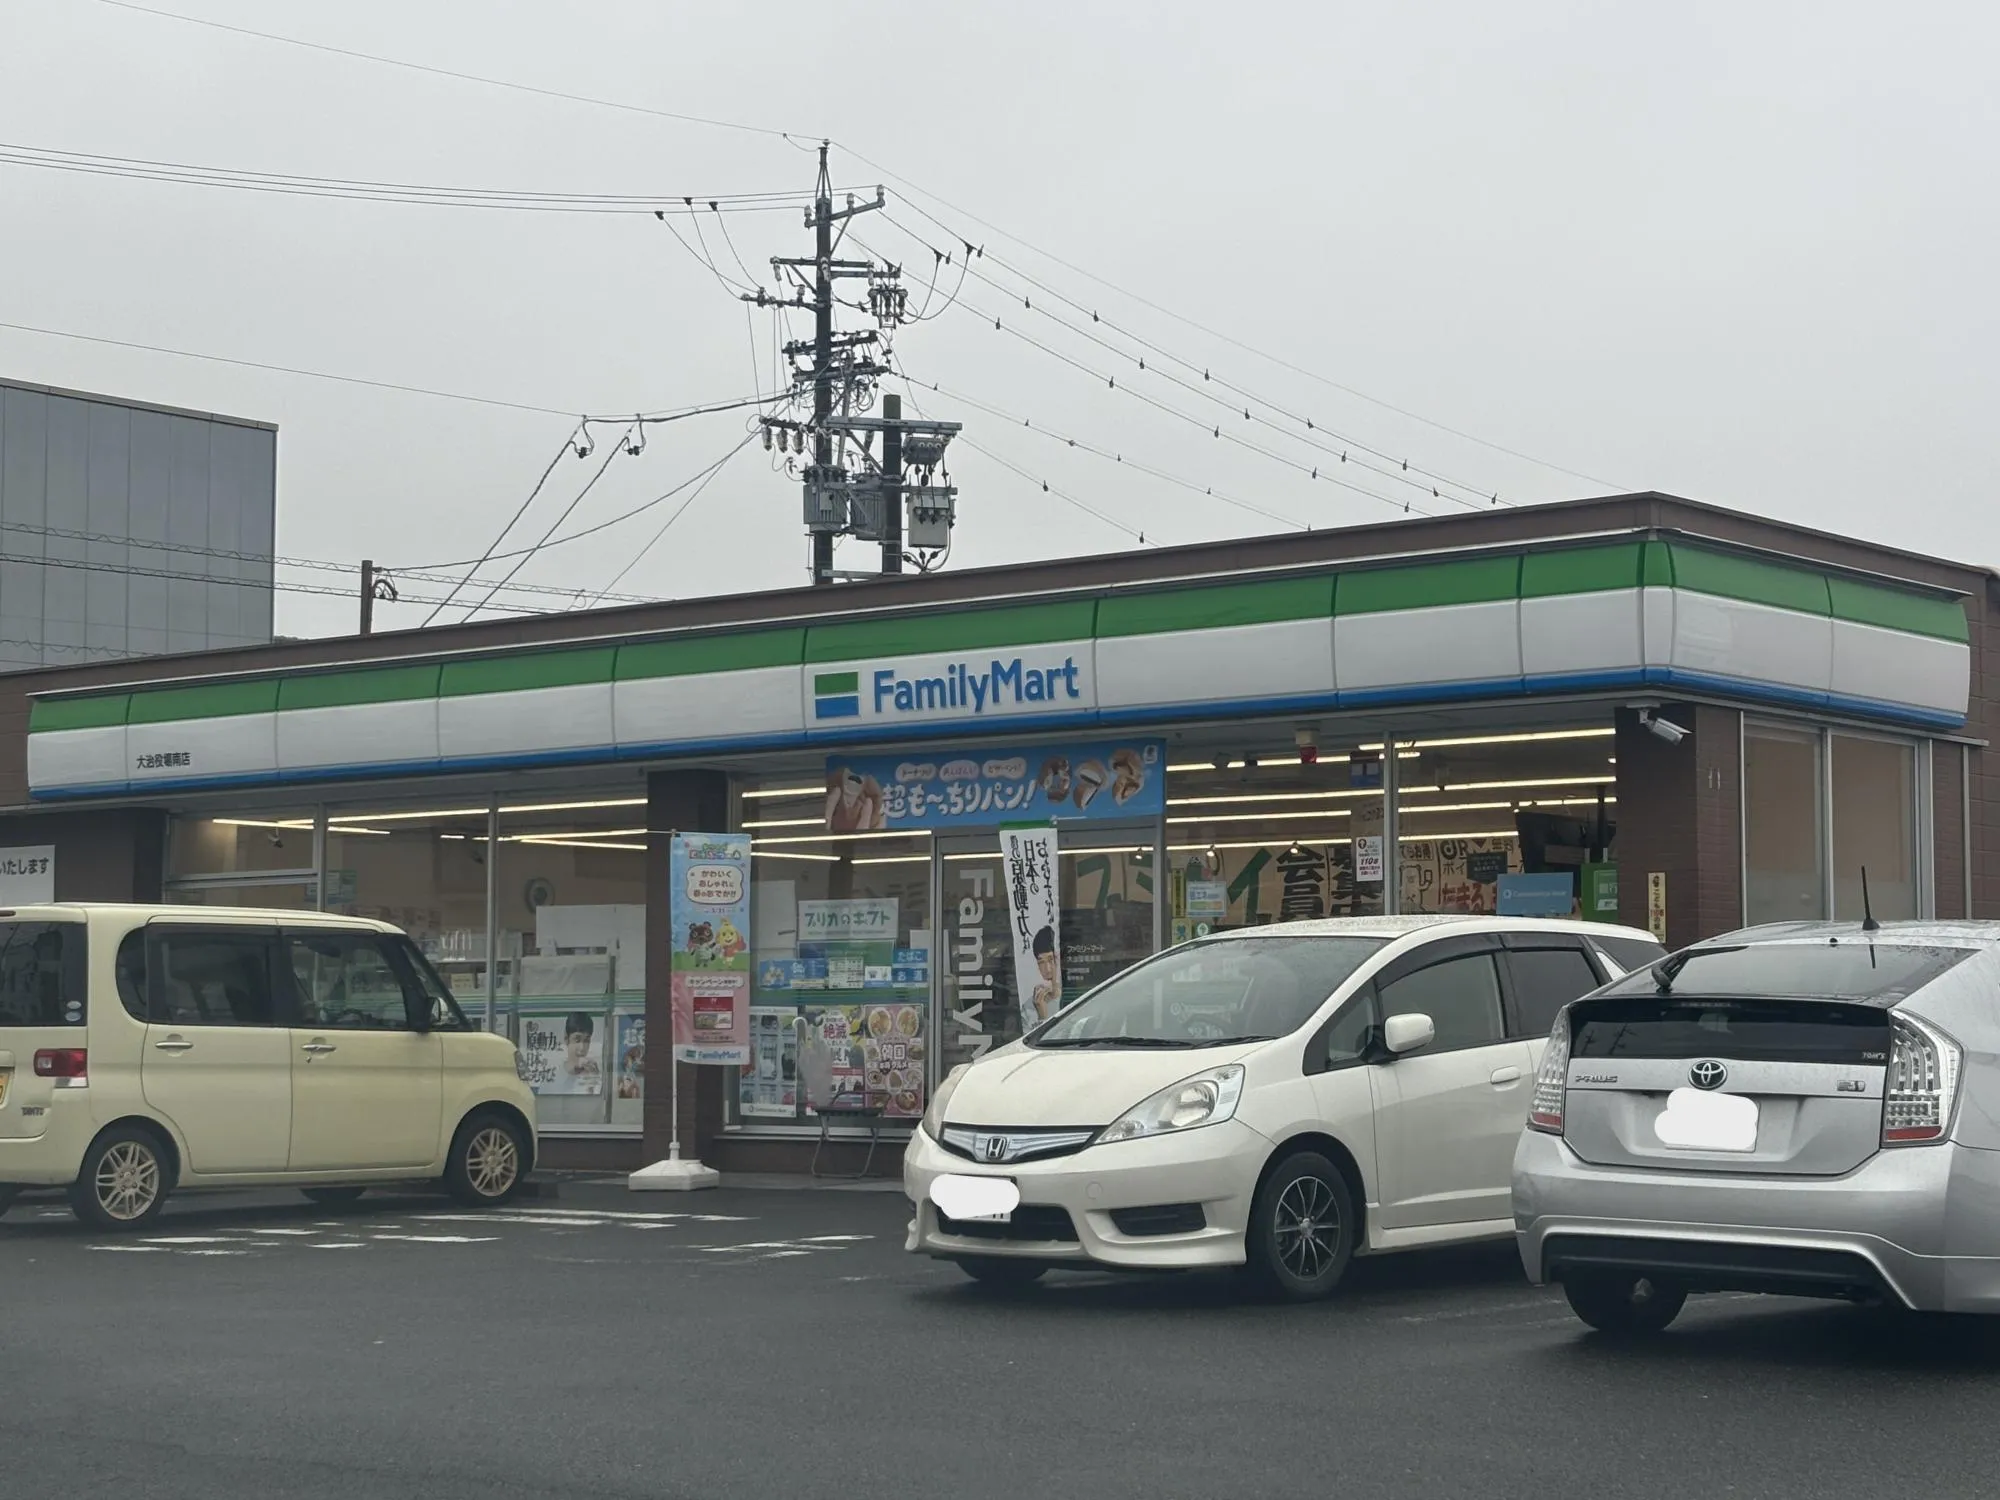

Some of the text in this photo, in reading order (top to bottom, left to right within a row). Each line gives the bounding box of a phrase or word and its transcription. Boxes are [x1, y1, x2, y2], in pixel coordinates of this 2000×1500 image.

[874, 656, 1079, 713] FamilyMart
[136, 752, 192, 769] 大治役場南店
[701, 870, 733, 878] かわいく
[897, 950, 923, 963] たばこ
[881, 1043, 906, 1061] 韓国
[1574, 1074, 1618, 1084] PRIUS
